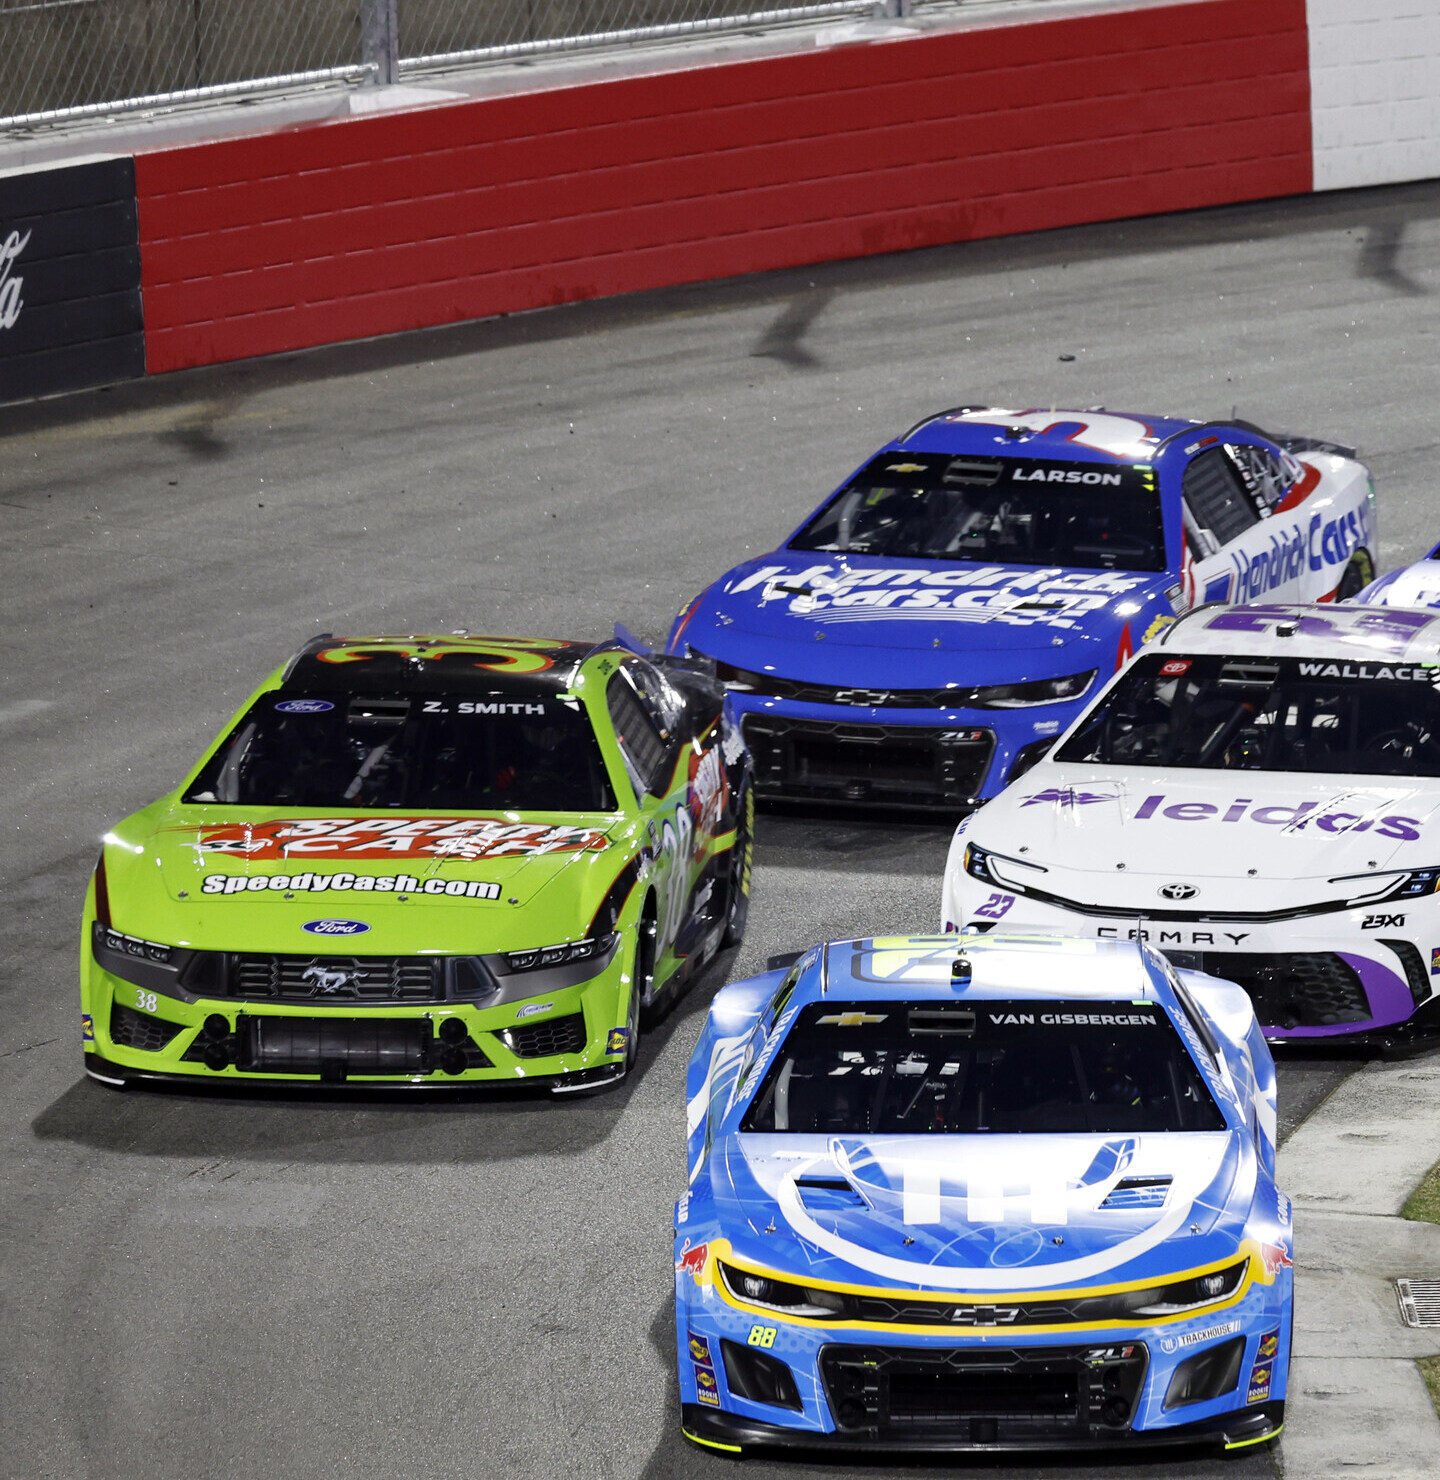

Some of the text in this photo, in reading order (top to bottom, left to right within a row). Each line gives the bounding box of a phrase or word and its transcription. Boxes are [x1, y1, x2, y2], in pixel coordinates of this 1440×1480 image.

[1012, 467, 1121, 486] LARSON
[1298, 662, 1430, 682] WALLACE
[422, 701, 545, 715] Z. SMITH
[201, 872, 503, 900] SpeedyCash.com
[973, 893, 1016, 919] 23
[135, 989, 158, 1013] 38
[988, 1013, 1157, 1026] VAN GISBERGEN
[747, 1325, 778, 1349] 88
[1181, 1323, 1232, 1345] TRACKHOUSE
[1084, 1346, 1134, 1361] ZL1
[698, 1388, 718, 1400] ROOKIE
